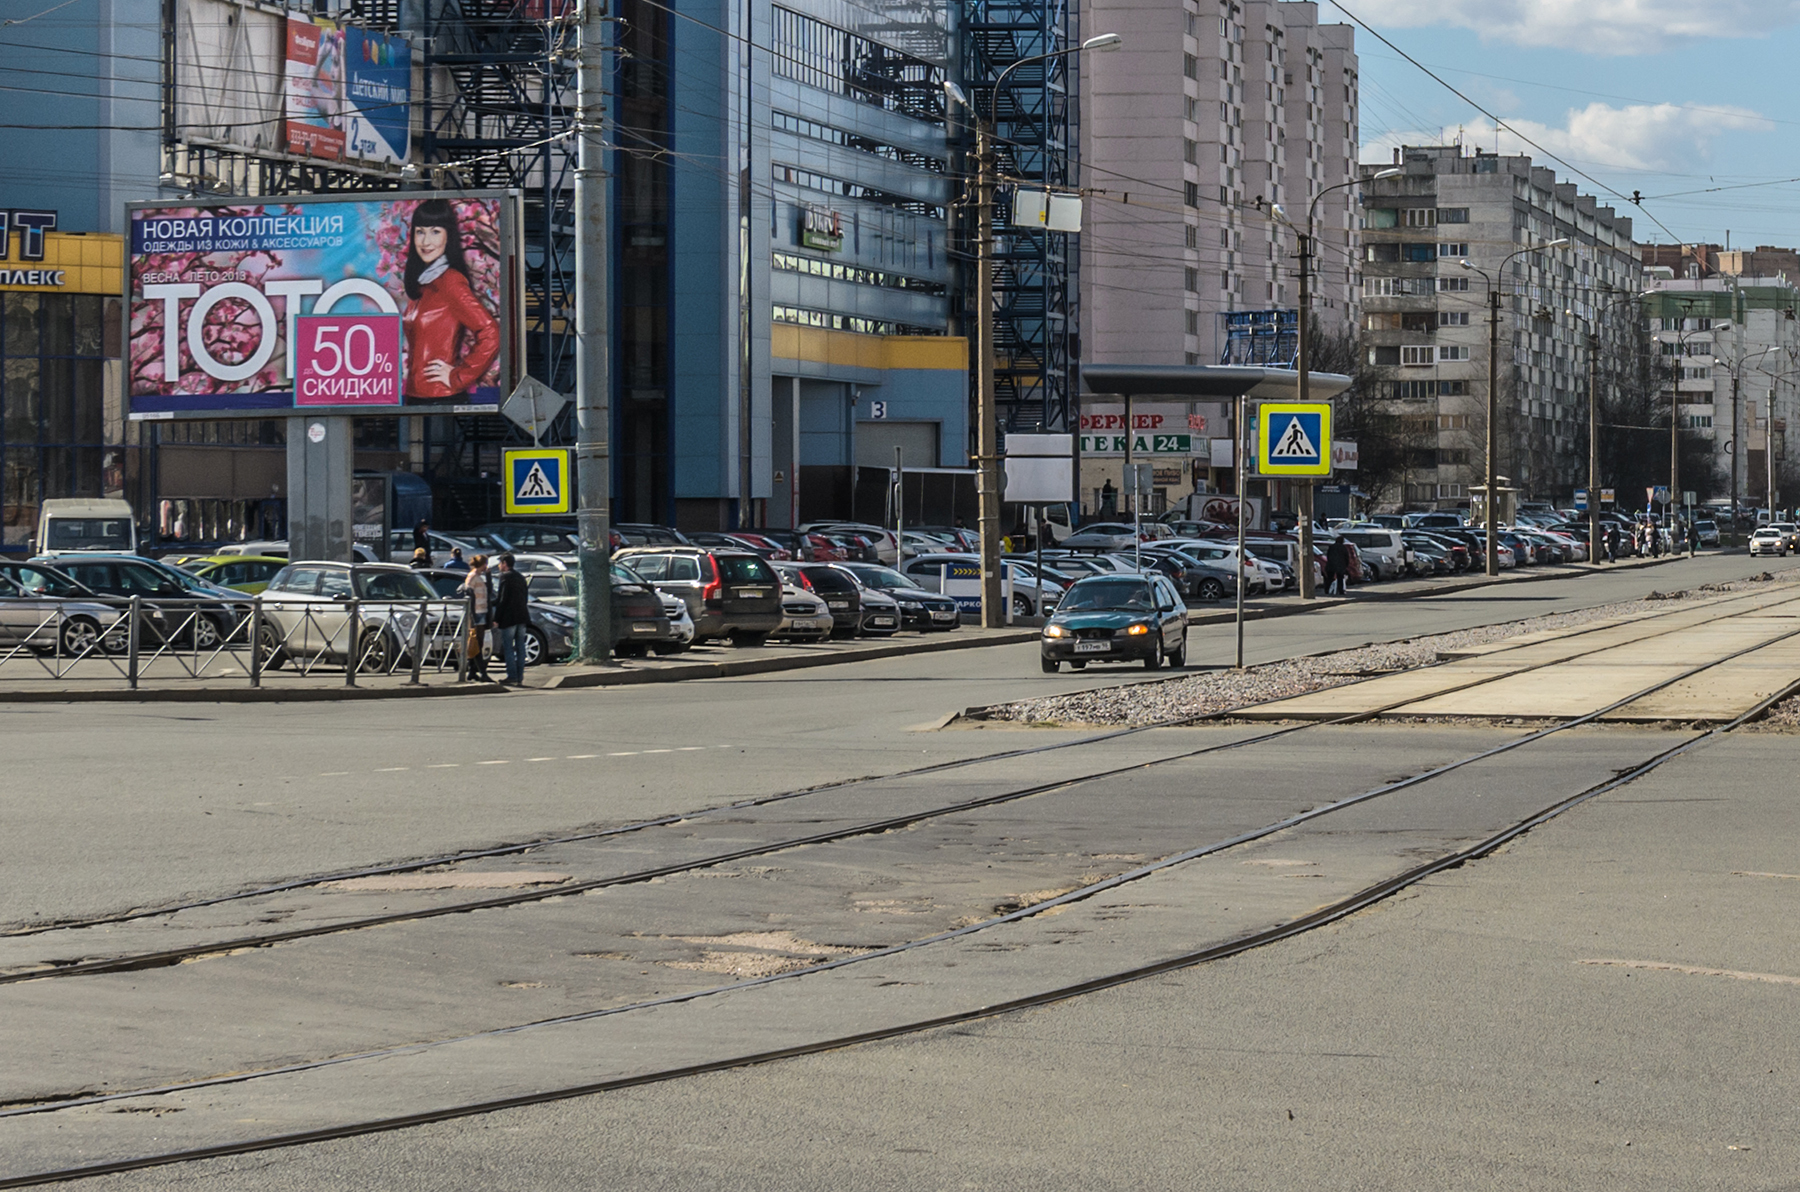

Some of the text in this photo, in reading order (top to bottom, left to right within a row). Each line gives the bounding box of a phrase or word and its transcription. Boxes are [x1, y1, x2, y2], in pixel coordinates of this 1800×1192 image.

[352, 71, 389, 101] Детский
[351, 117, 359, 151] 2
[361, 139, 377, 154] этаж
[0, 211, 57, 258] Т
[143, 216, 344, 239] НОВАЯ КОЛЛЕКЦИЯ
[143, 236, 343, 253] ОДЕЖДЫ ИЗ КОЖИ & АКСЕССУАРОВ
[143, 273, 180, 283] ВЕСНА
[189, 272, 219, 282] ЛЕТО
[221, 271, 246, 281] 2013
[311, 324, 393, 377] 50%
[303, 378, 392, 398] СКИДКИ!
[874, 401, 884, 418] 3
[1157, 436, 1178, 450] 24
